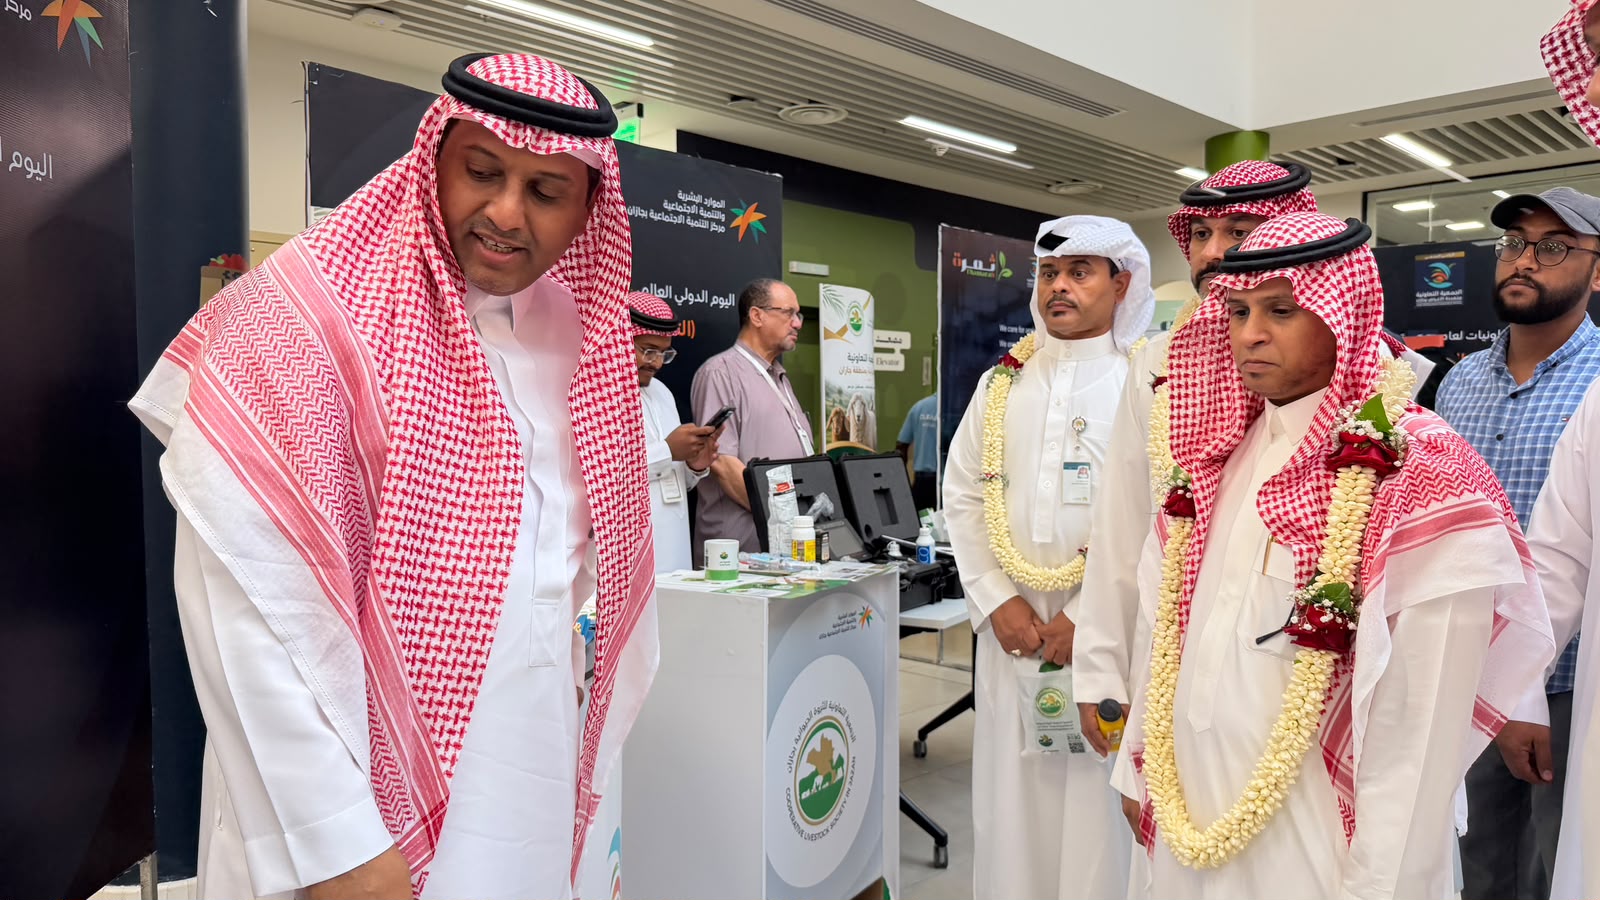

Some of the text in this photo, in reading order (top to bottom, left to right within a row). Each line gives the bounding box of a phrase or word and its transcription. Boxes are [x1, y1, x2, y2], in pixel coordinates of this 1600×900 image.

[8, 151, 53, 181] اليوم
[677, 189, 726, 209] الموارد البشرية
[627, 205, 726, 233] مركز التنمية الاجتماعية بجازان
[662, 199, 726, 222] والتنمية الاجتماعية
[952, 251, 996, 272] ثمرة
[674, 287, 708, 306] الدولي
[710, 293, 736, 309] اليوم
[875, 357, 900, 366] Elevator
[785, 787, 805, 838] COOPERATIVE
[803, 826, 830, 842] LIVESTOCK
